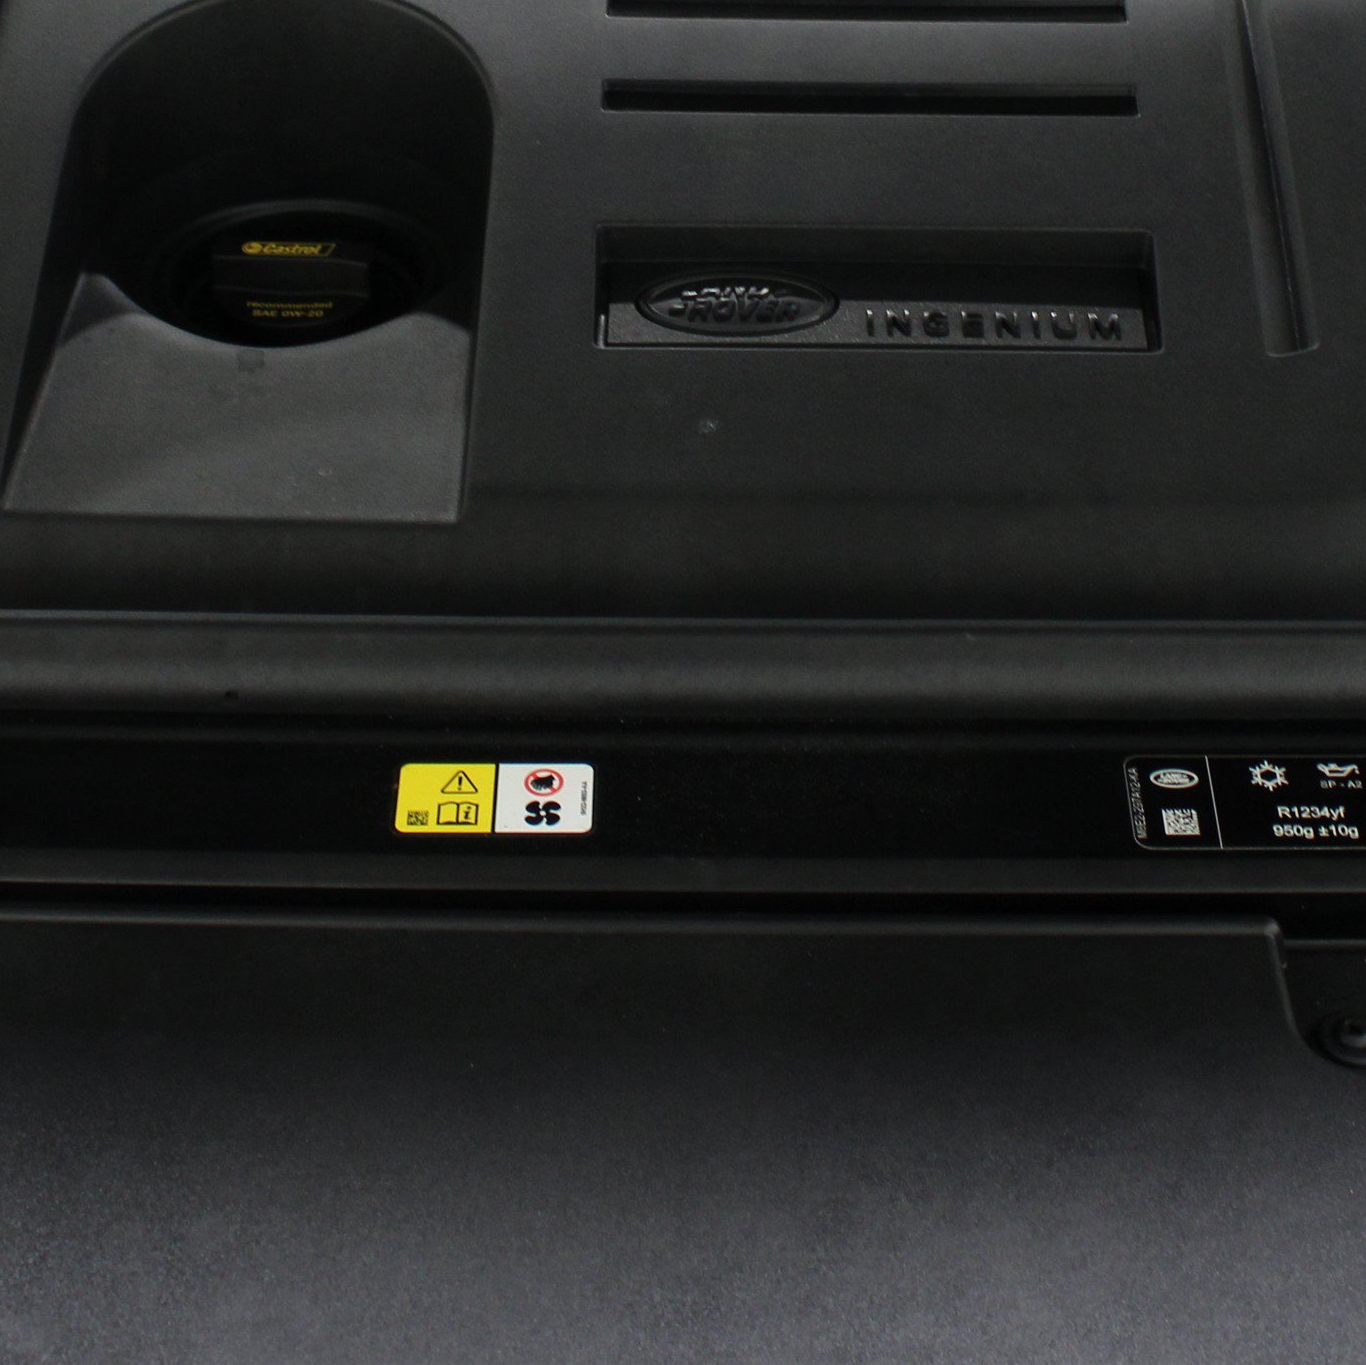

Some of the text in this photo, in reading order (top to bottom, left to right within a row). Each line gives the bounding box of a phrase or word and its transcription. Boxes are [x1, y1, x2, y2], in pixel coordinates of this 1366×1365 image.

[262, 242, 323, 255] Castrol
[246, 301, 333, 309] recommended
[252, 309, 277, 318] SAE
[687, 299, 799, 323] ROVER
[865, 308, 1123, 342] INGENIUM
[1277, 805, 1346, 822] R1234yf
[1272, 823, 1360, 840] 950g ±10g
